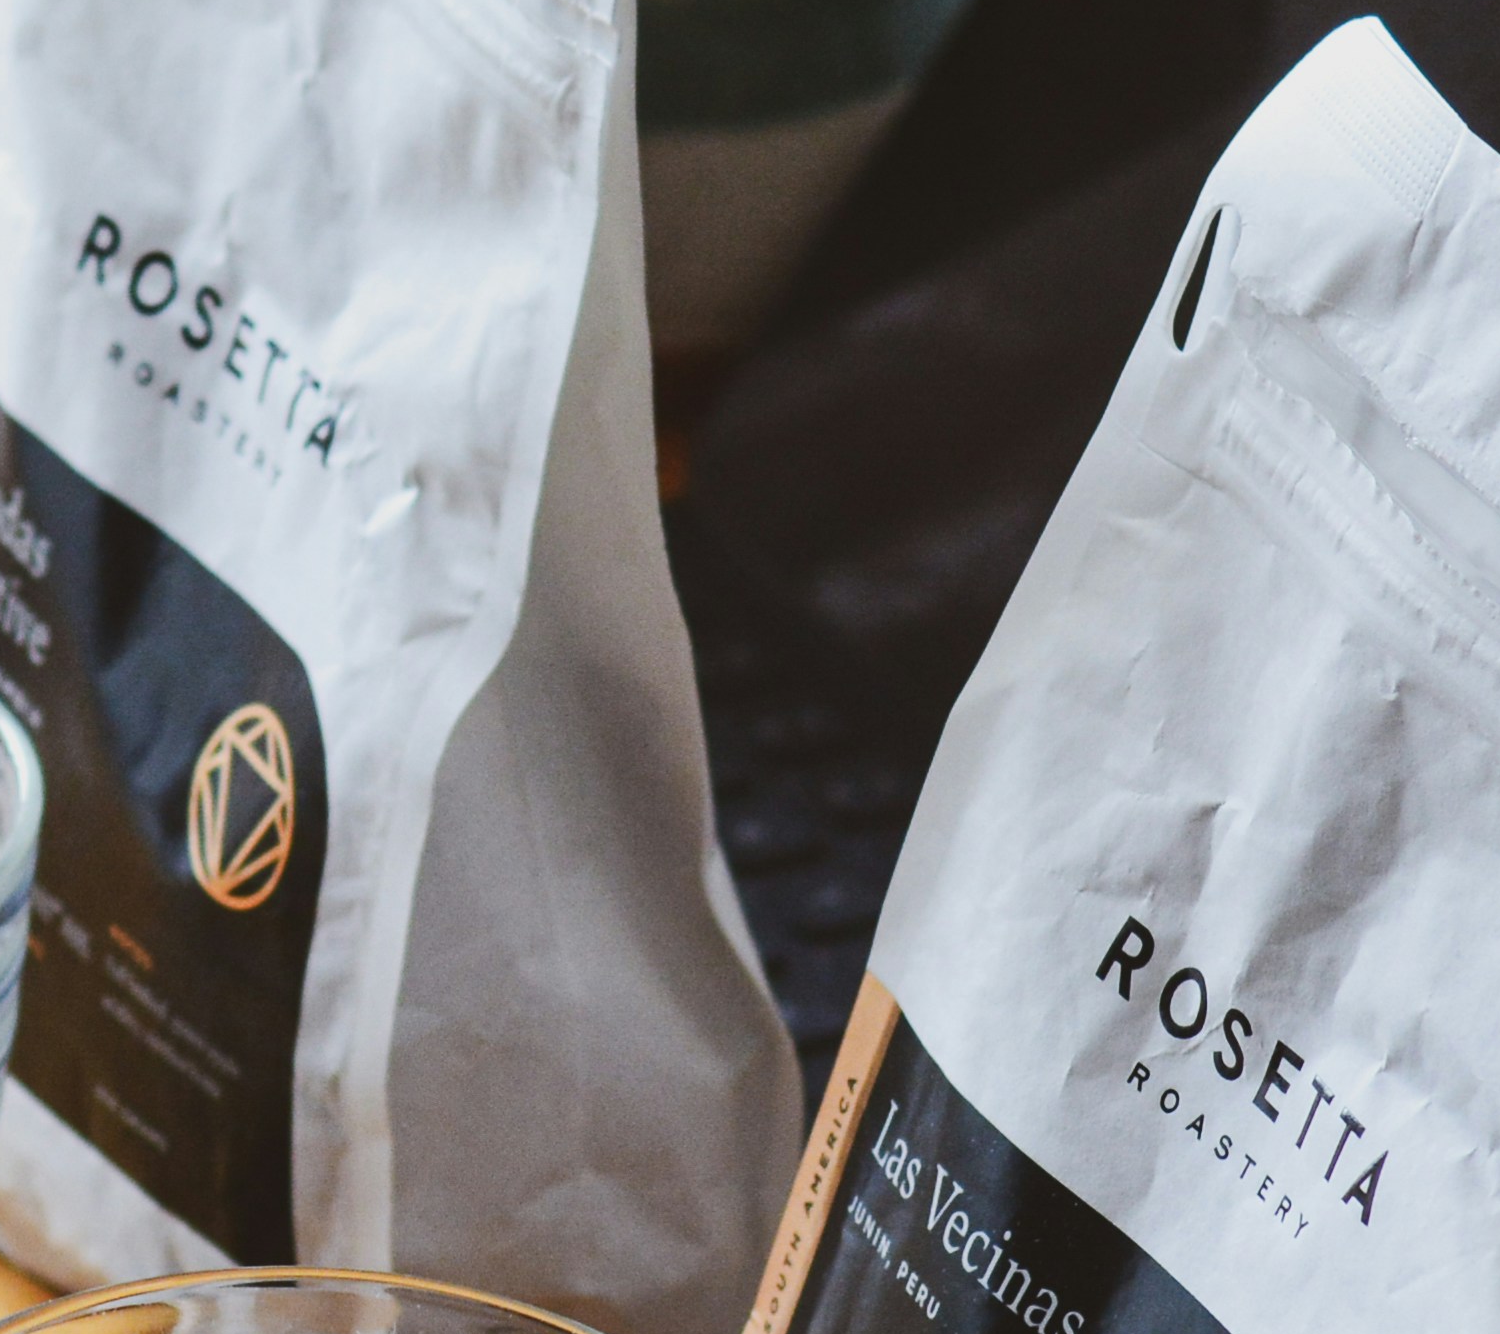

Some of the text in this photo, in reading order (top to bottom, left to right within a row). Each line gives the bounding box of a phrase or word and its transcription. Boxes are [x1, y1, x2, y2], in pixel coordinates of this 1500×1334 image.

[75, 213, 344, 469] ROSETTA
[871, 1099, 922, 1199] Las
[1095, 915, 1389, 1226] ROSETTA
[1126, 1062, 1309, 1239] ROASTERY
[763, 1233, 801, 1334] SOUTH
[803, 1076, 858, 1219] AMERICA
[848, 1196, 940, 1320] JUNIN, PERU
